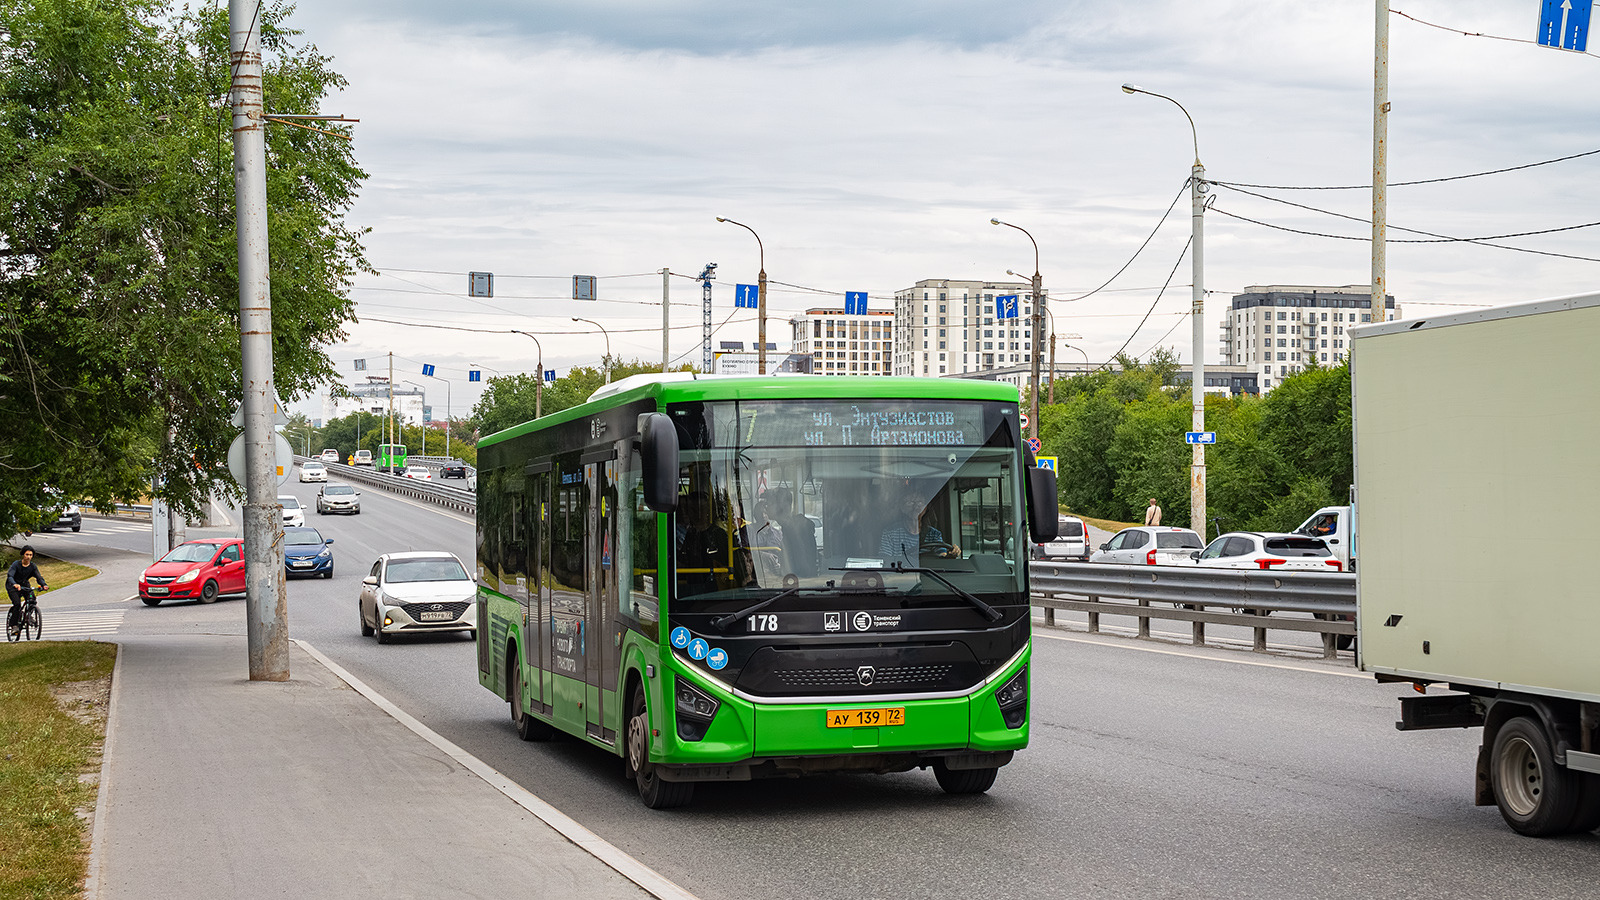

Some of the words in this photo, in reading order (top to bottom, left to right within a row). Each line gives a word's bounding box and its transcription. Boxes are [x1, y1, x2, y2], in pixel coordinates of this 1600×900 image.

[742, 409, 757, 442] 7
[812, 412, 839, 426] ул.
[850, 405, 955, 426] Энтузиастов
[804, 431, 831, 446] ул.
[842, 424, 860, 446] П.
[870, 424, 965, 446] Артамонова
[748, 614, 778, 632] 178
[834, 714, 849, 725] АУ
[856, 711, 880, 724] 139
[887, 709, 900, 720] 72
